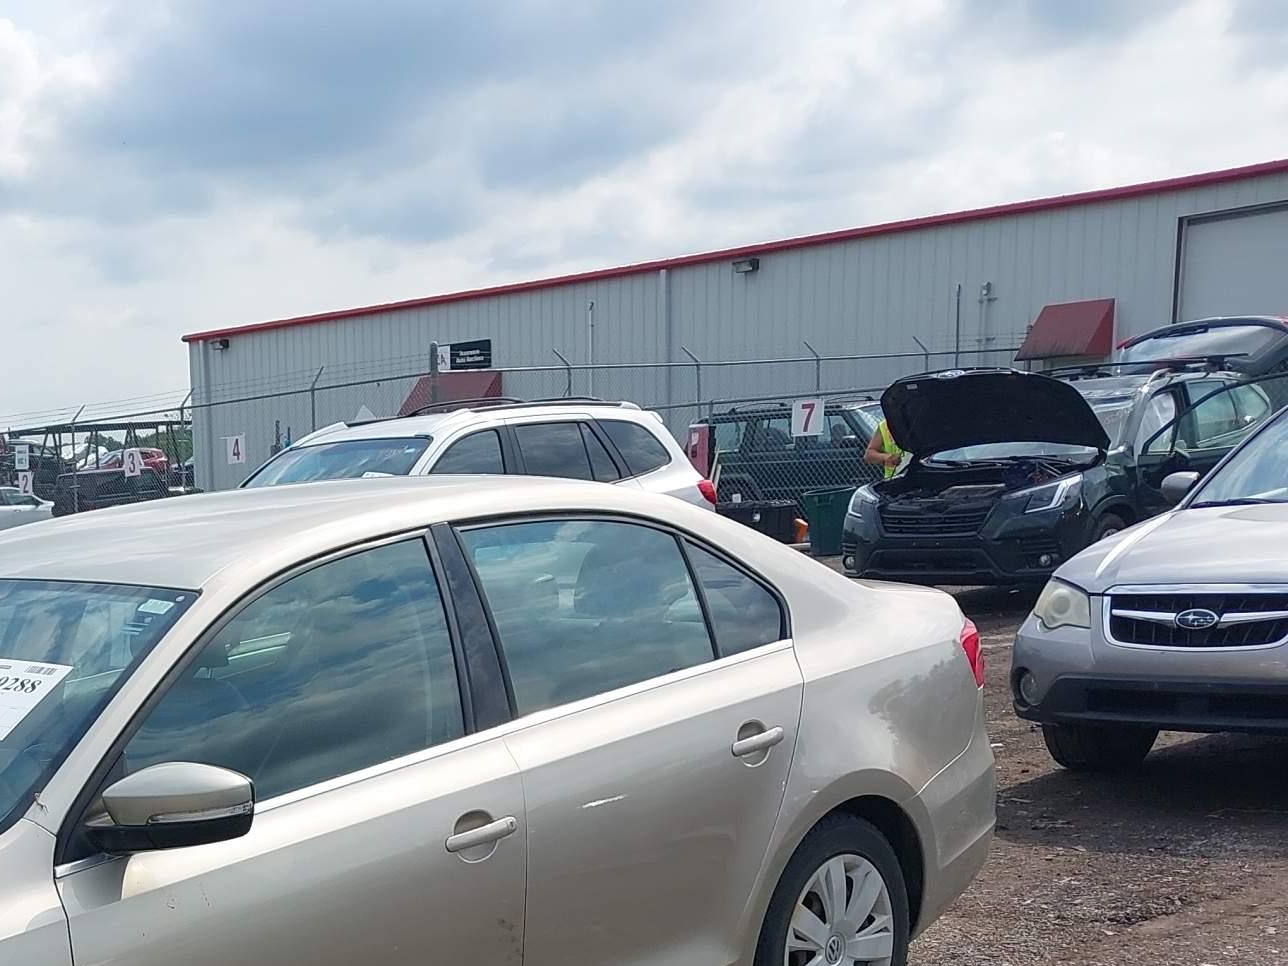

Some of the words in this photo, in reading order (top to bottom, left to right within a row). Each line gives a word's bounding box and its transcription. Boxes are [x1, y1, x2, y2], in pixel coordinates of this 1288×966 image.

[801, 403, 815, 433] 7
[232, 438, 241, 461] 4
[128, 452, 136, 474] 3
[22, 474, 30, 494] 2
